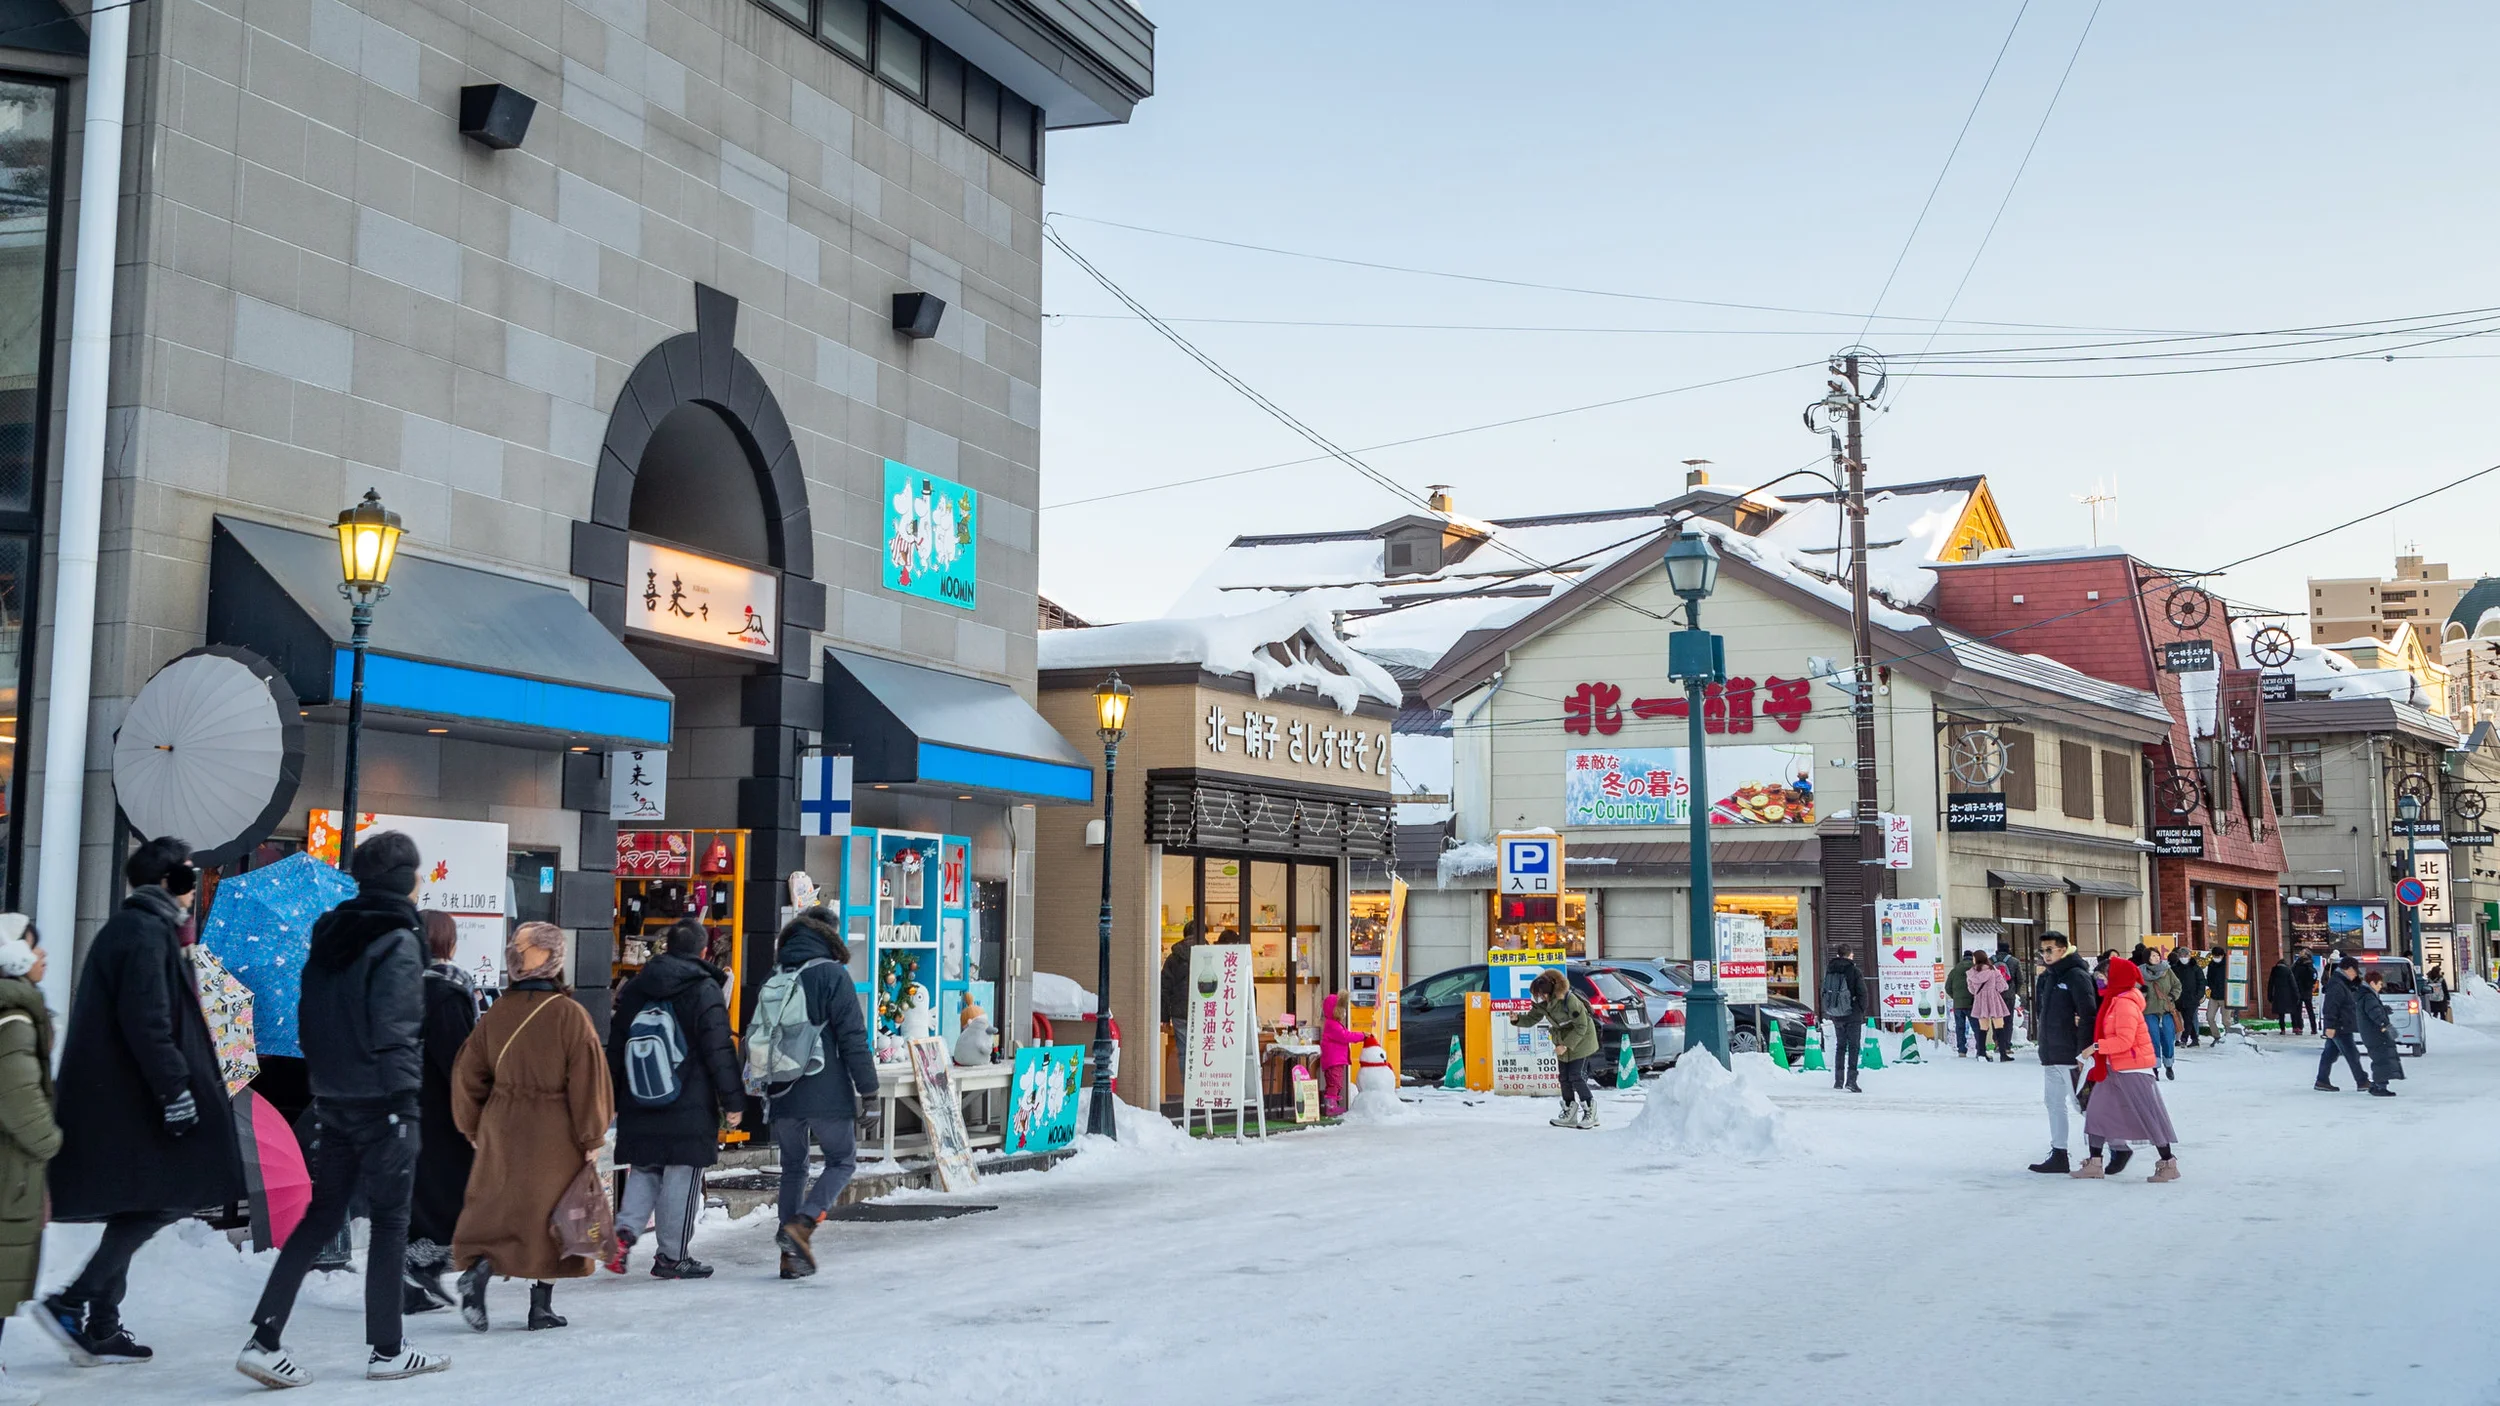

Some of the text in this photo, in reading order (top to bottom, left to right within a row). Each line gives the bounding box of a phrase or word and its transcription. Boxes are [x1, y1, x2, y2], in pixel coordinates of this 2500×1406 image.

[643, 569, 709, 622] 喜来々
[941, 576, 975, 602] MOOMIN
[1564, 676, 1812, 736] 北一硝子
[1207, 705, 1387, 775] 北一硝子 さしすせそ 2
[1576, 755, 1620, 770] 素敵な
[1602, 771, 1690, 797] 冬の暮ら
[1950, 814, 2004, 823] カントリーフロア
[1890, 817, 1909, 853] 地酒
[2182, 829, 2202, 837] GLASS
[1514, 846, 1544, 871] P
[1511, 878, 1548, 890] 入口
[2420, 861, 2440, 917] 北一硝子
[878, 925, 921, 942] MOOMIN
[1222, 951, 1238, 1048] 液だれしない
[1202, 1001, 1217, 1067] 醤油差し
[1195, 1098, 1233, 1107] 北一硝子
[1048, 1123, 1075, 1144] MOOMIN
